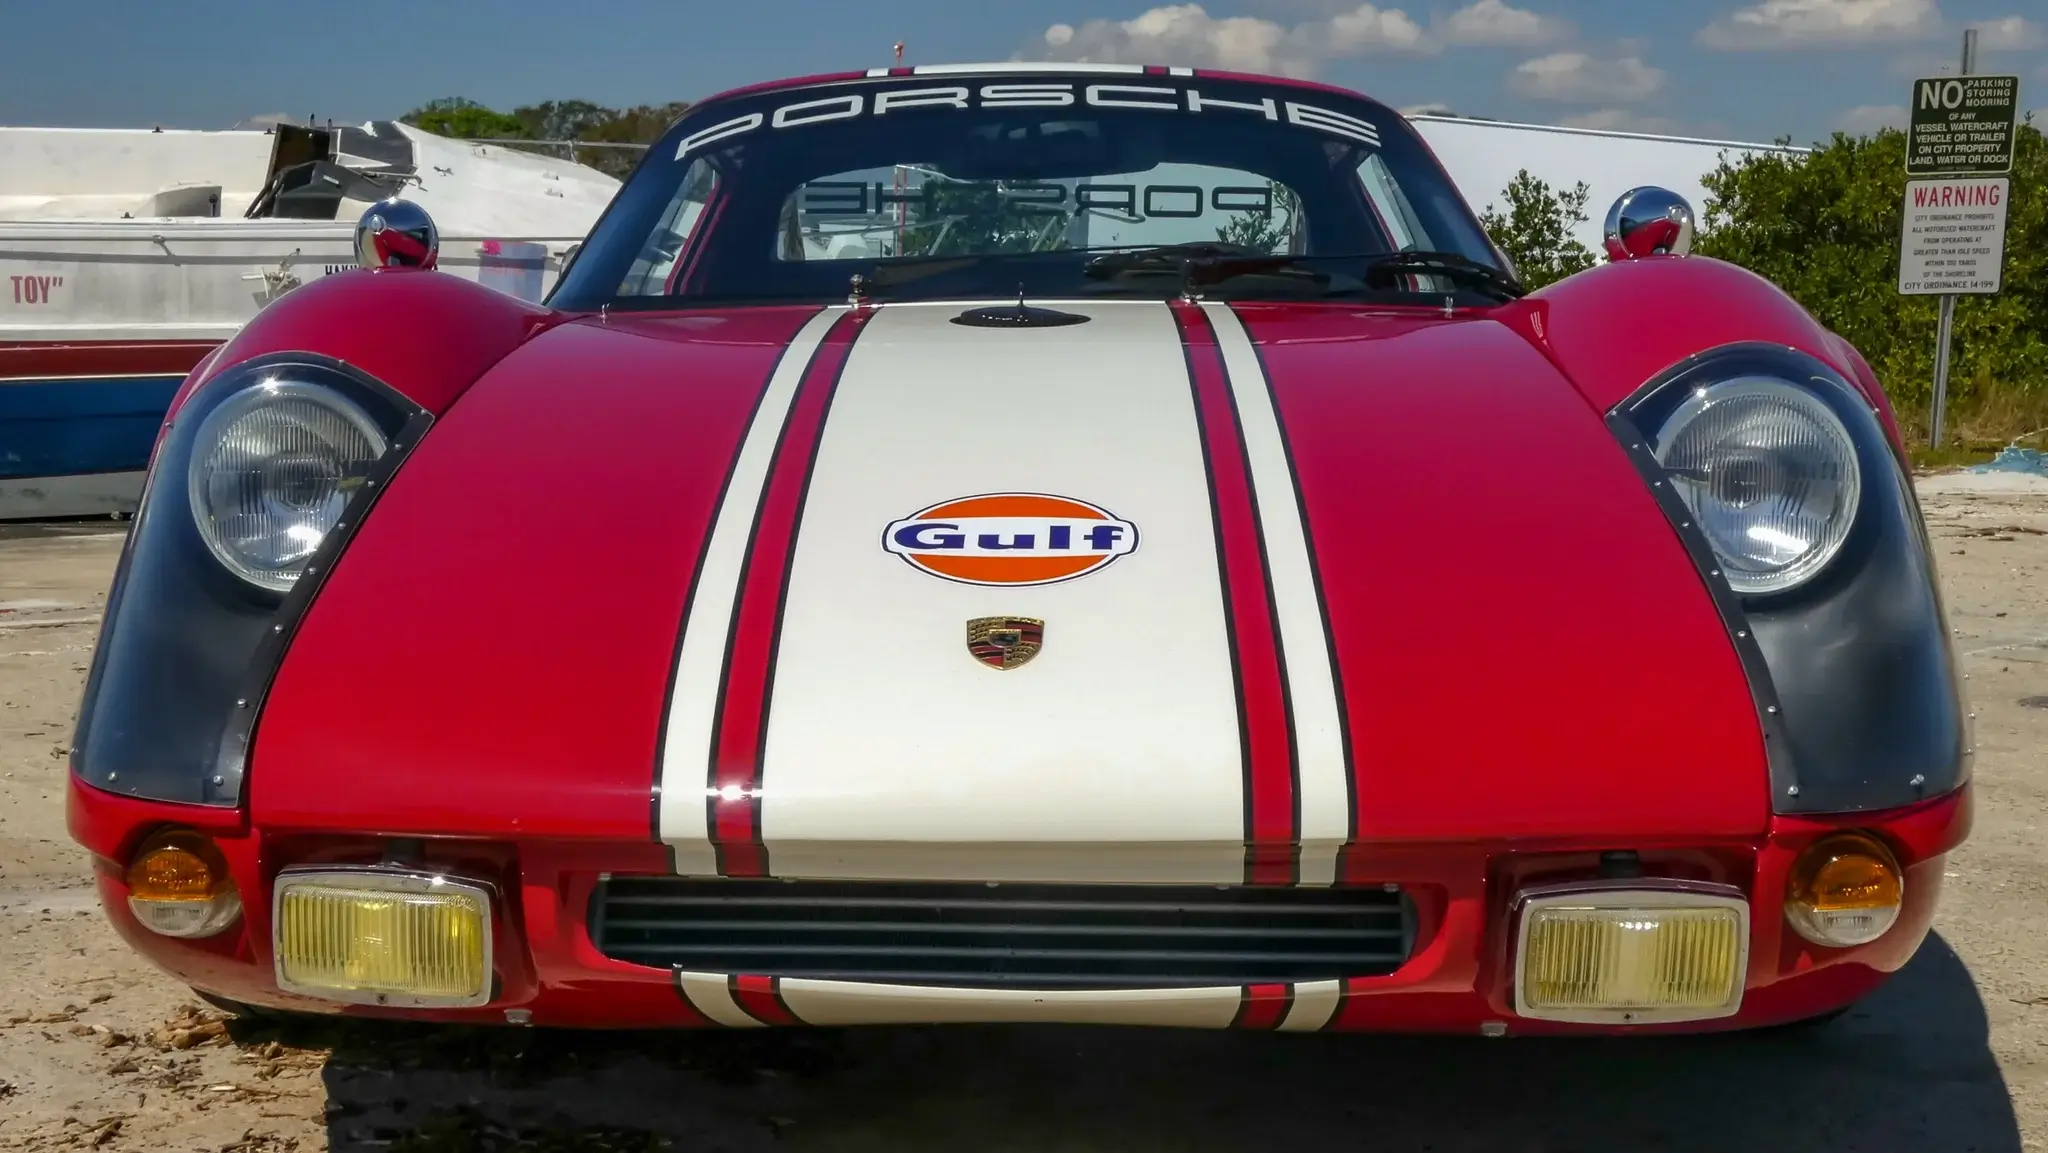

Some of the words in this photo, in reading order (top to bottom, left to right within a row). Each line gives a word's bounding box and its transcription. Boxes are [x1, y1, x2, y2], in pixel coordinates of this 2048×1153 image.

[1966, 79, 2012, 88] PARKING
[1920, 80, 1964, 110] NO
[1966, 88, 2011, 98] STORING
[1965, 98, 2010, 107] MOORING
[1960, 112, 1977, 120] ANY
[673, 84, 1382, 162] PORSCHE
[1915, 123, 1948, 133] VESSEL
[1950, 121, 2009, 131] WATERCRAFT
[1916, 133, 1952, 143] VEHICLE
[1954, 133, 1967, 142] OR
[1969, 132, 2006, 142] TRAILER
[1918, 145, 1932, 154] ON
[1933, 145, 1953, 153] CITY
[1954, 143, 2002, 153] PROPERTY
[1909, 156, 1935, 166] LAND,
[1936, 155, 1967, 164] WATER
[1968, 155, 1981, 164] OR
[1983, 154, 2009, 164] DOCK
[1914, 184, 2000, 208] WARNING
[1914, 214, 1928, 222] CITY
[1958, 224, 1996, 232] WATERCRAFT
[10, 275, 64, 305] TOY"
[1904, 282, 1921, 290] CITY
[1923, 281, 1968, 290] ORDINANCE
[894, 523, 1124, 550] Gulf
